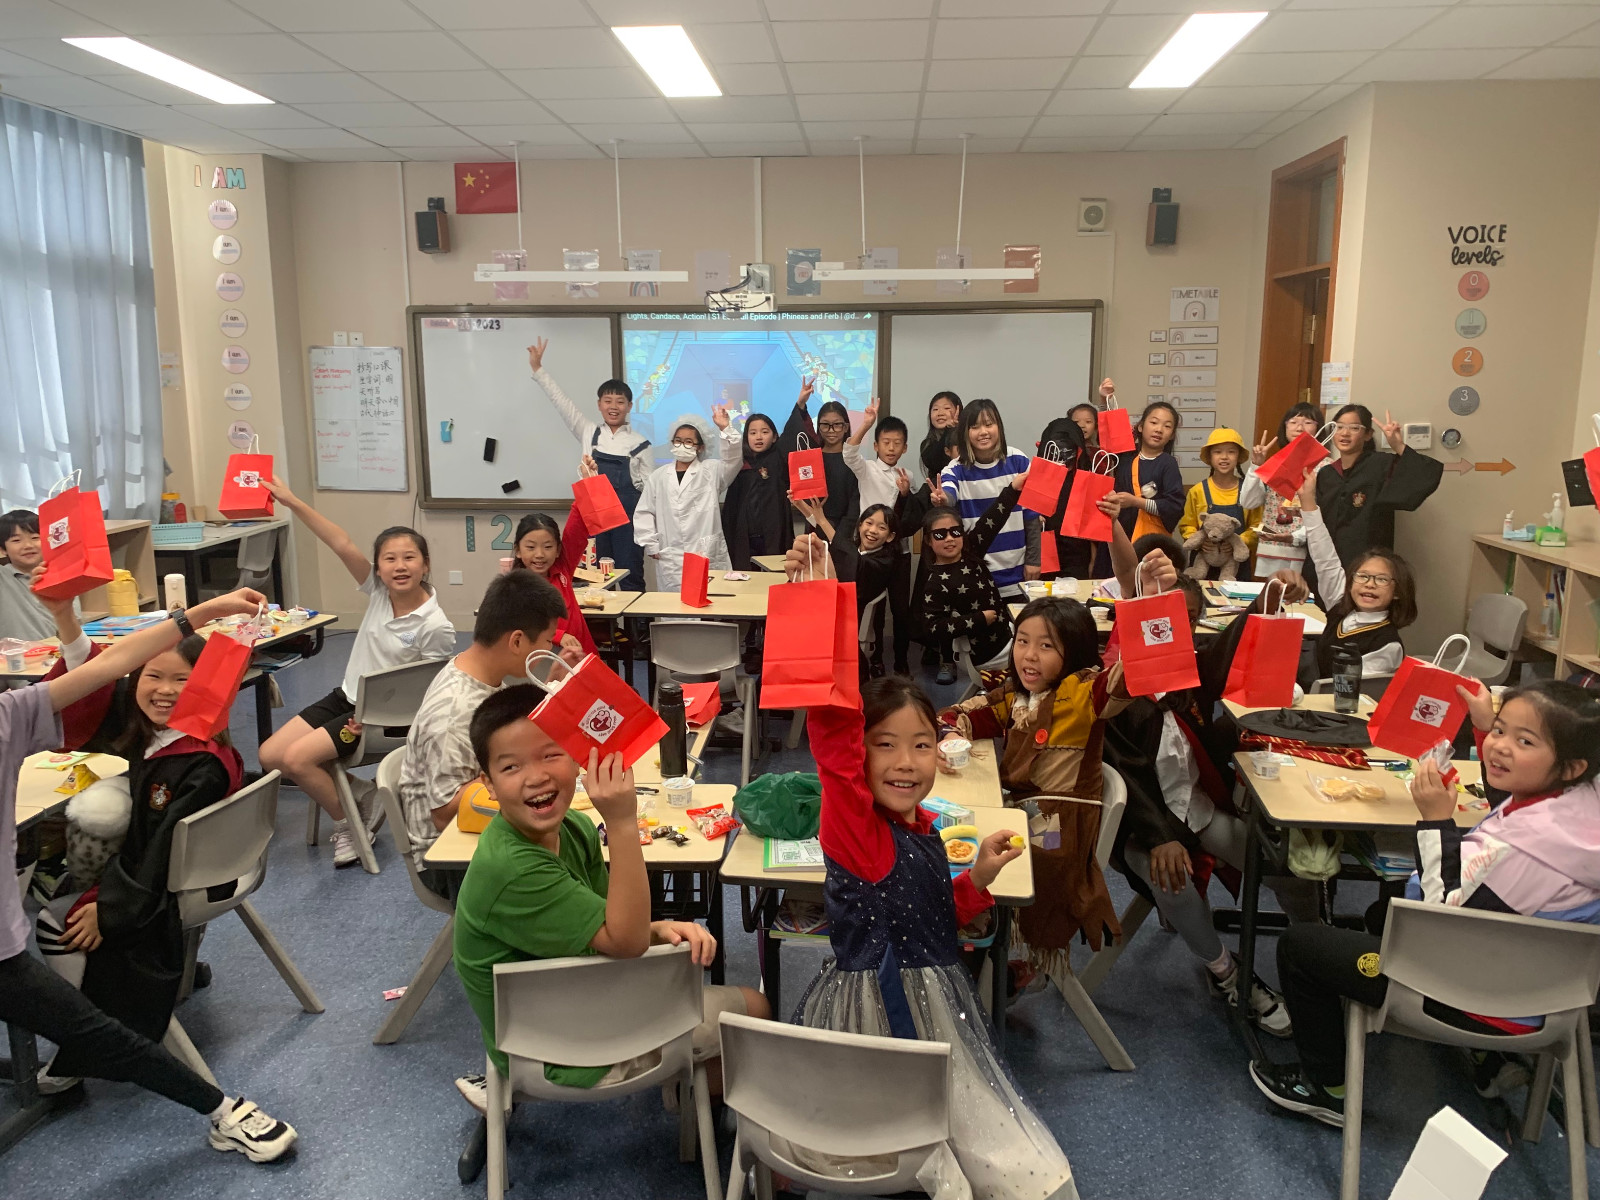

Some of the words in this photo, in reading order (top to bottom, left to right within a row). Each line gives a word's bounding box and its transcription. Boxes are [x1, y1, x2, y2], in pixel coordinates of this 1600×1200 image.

[194, 164, 202, 188] I
[211, 166, 247, 189] AM
[1447, 223, 1507, 245] VOICE
[1451, 245, 1504, 267] levels
[1469, 273, 1479, 286] 0
[1171, 288, 1219, 299] TIMETABLE
[626, 312, 649, 321] Lights,
[650, 312, 681, 321] Candace,
[683, 312, 706, 320] Action!
[711, 312, 720, 320] S1
[750, 312, 777, 321] Episode
[782, 312, 809, 320] Phineas
[810, 312, 822, 320] and
[825, 312, 839, 320] Ferb
[476, 319, 501, 330] 2023
[1463, 350, 1473, 362] 2
[1460, 389, 1469, 401] 3
[490, 513, 514, 551] 2
